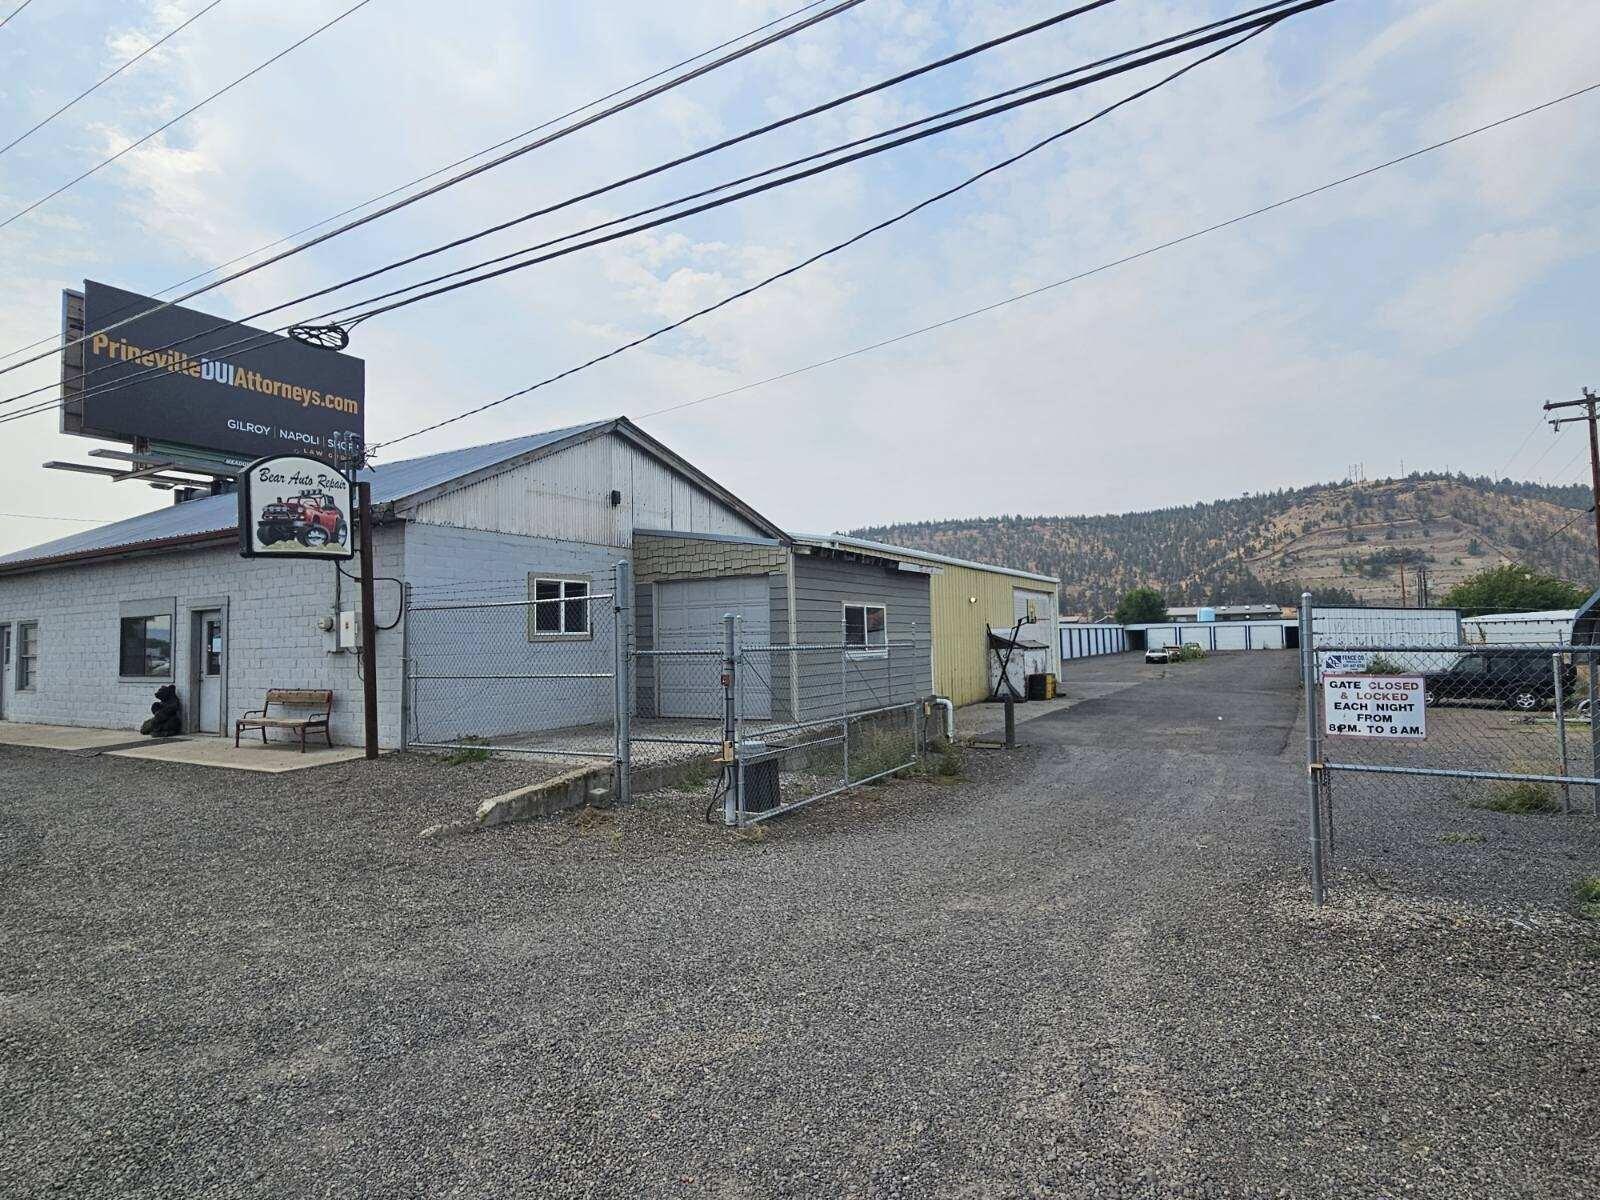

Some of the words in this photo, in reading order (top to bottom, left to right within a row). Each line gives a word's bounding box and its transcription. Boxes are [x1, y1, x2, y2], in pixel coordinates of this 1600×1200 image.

[227, 419, 271, 436] GILROY
[279, 429, 320, 446] NAPOLI
[259, 467, 285, 483] Bear
[288, 470, 313, 486] Auto
[317, 474, 347, 491] Repair
[1329, 681, 1361, 690] GATE
[1368, 682, 1419, 691] CLOSED
[1340, 692, 1349, 700] &
[1357, 692, 1409, 701] LOCKED
[1334, 702, 1368, 711] EACH
[1376, 703, 1415, 712] NIGHT
[1357, 714, 1393, 723] FROM
[1367, 725, 1384, 734] TO
